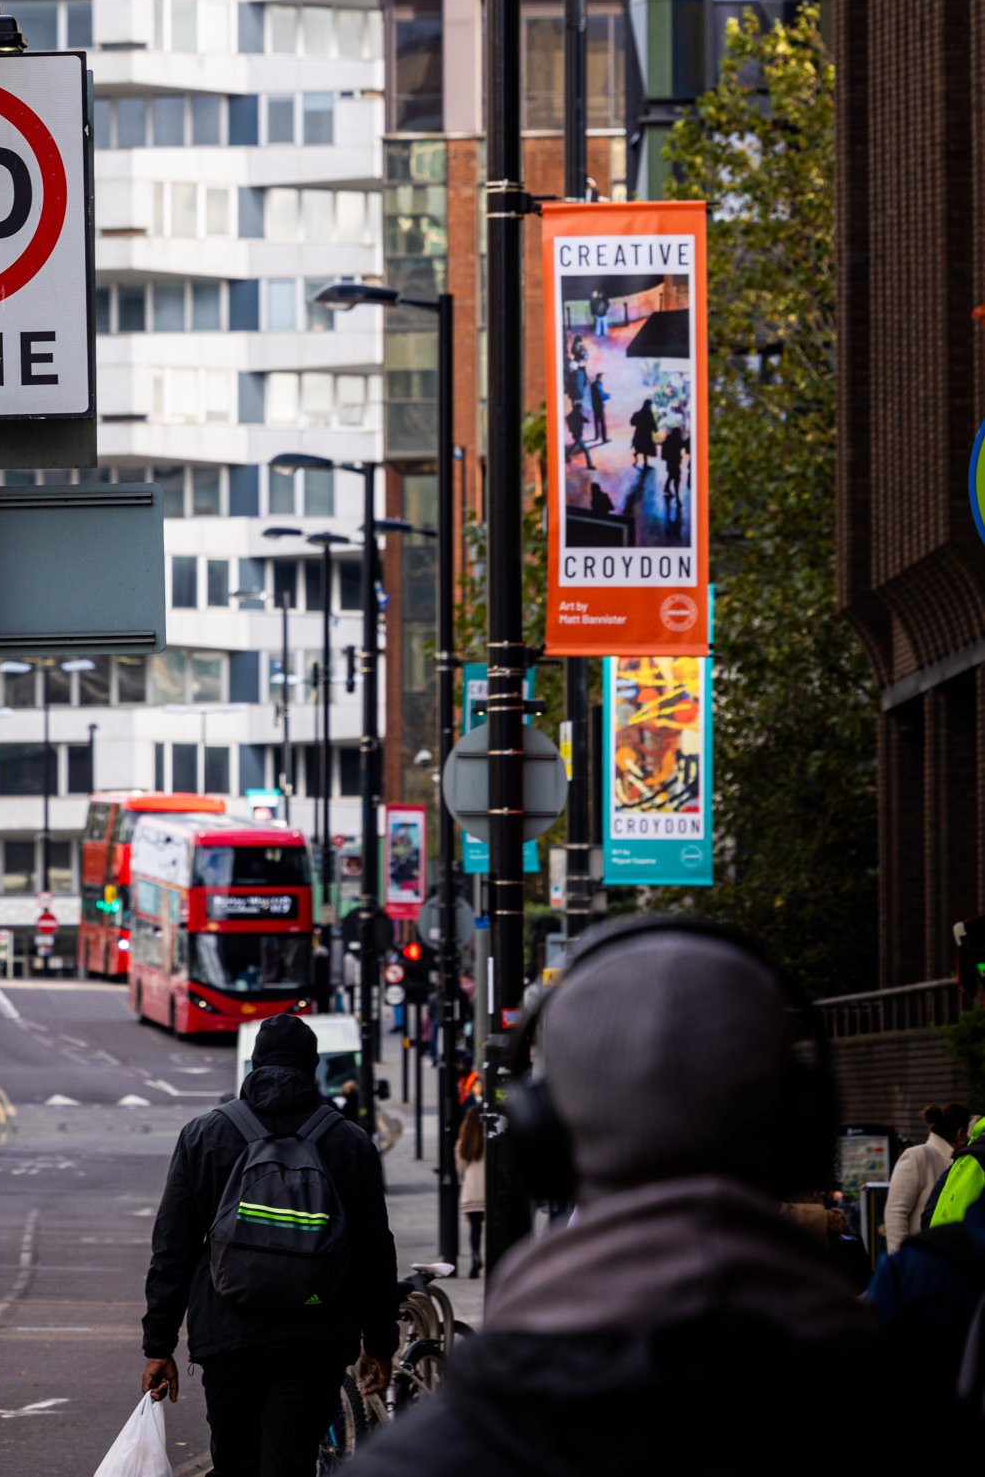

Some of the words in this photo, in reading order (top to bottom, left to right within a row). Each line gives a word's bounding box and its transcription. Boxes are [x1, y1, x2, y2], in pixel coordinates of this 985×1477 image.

[559, 242, 690, 268] CREATIVE
[564, 555, 692, 580] CROYDON
[559, 601, 574, 612] Art
[575, 601, 589, 613] by
[613, 818, 701, 835] CROYDON
